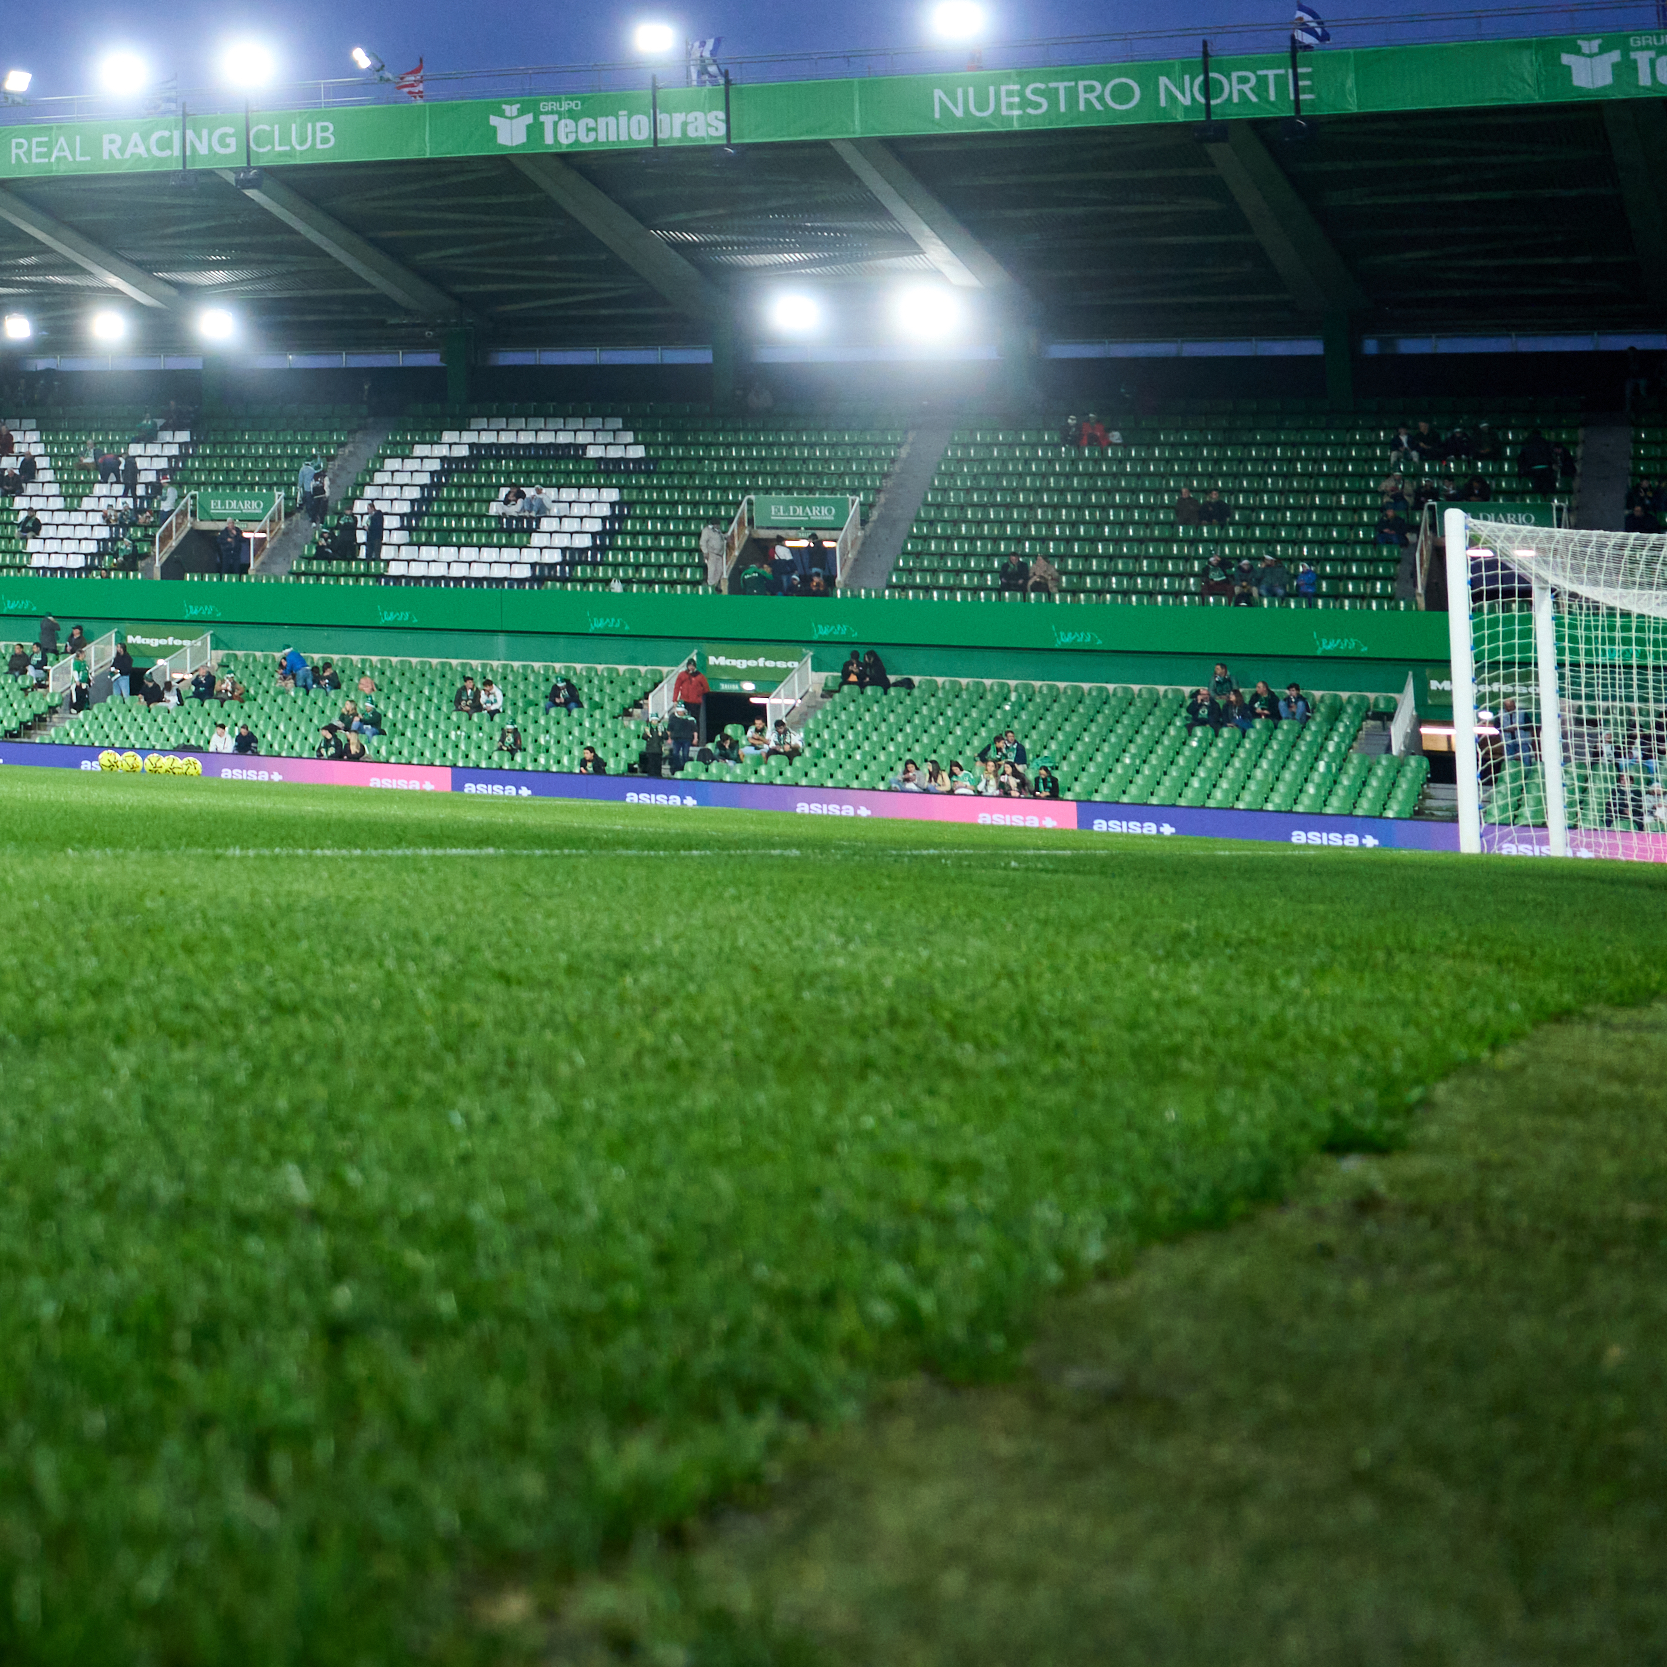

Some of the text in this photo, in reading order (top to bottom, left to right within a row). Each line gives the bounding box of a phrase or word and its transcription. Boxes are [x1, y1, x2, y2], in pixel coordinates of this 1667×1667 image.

[1630, 34, 1667, 47] GRU
[933, 67, 1316, 119] NUESTRO NORTE
[540, 100, 581, 111] GRUPO
[539, 109, 727, 145] Tecniobras
[11, 121, 335, 164] REAL RACING CLUB
[210, 499, 264, 510] EL DIARIO
[771, 505, 836, 516] EL DIARIO
[1479, 513, 1535, 524] DIARIO
[127, 635, 202, 647] Magefesa
[708, 655, 799, 669] Magefesa
[1429, 679, 1540, 694] Mefesa
